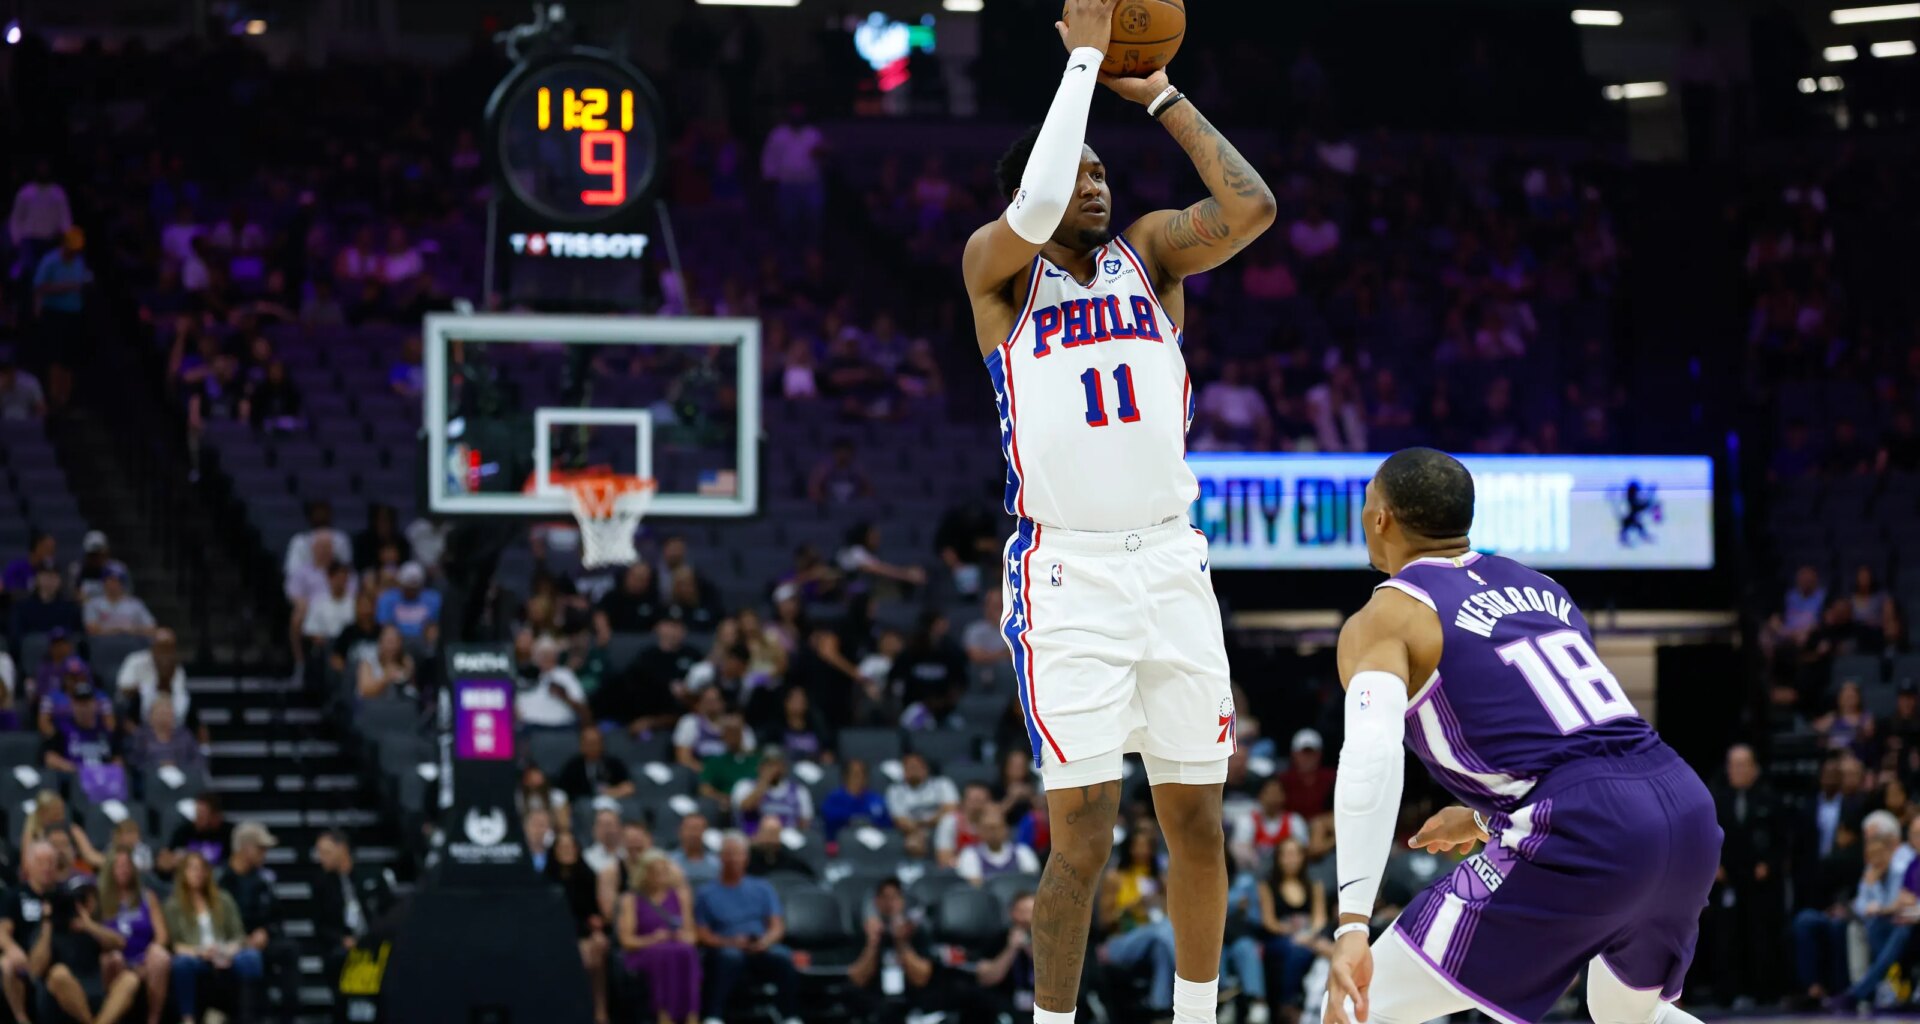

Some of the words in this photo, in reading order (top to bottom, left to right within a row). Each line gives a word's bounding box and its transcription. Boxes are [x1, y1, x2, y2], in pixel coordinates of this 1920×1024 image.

[538, 87, 633, 132] 11:21
[581, 130, 626, 206] 9
[546, 232, 648, 258] TISSOT
[1032, 294, 1163, 359] PHILA
[1080, 363, 1141, 427] 11
[1196, 478, 1282, 545] CITY
[1295, 477, 1371, 545] EDIT
[1475, 472, 1574, 552] IGHT
[1454, 586, 1572, 638] WESTBROOK
[1495, 630, 1638, 736] 18
